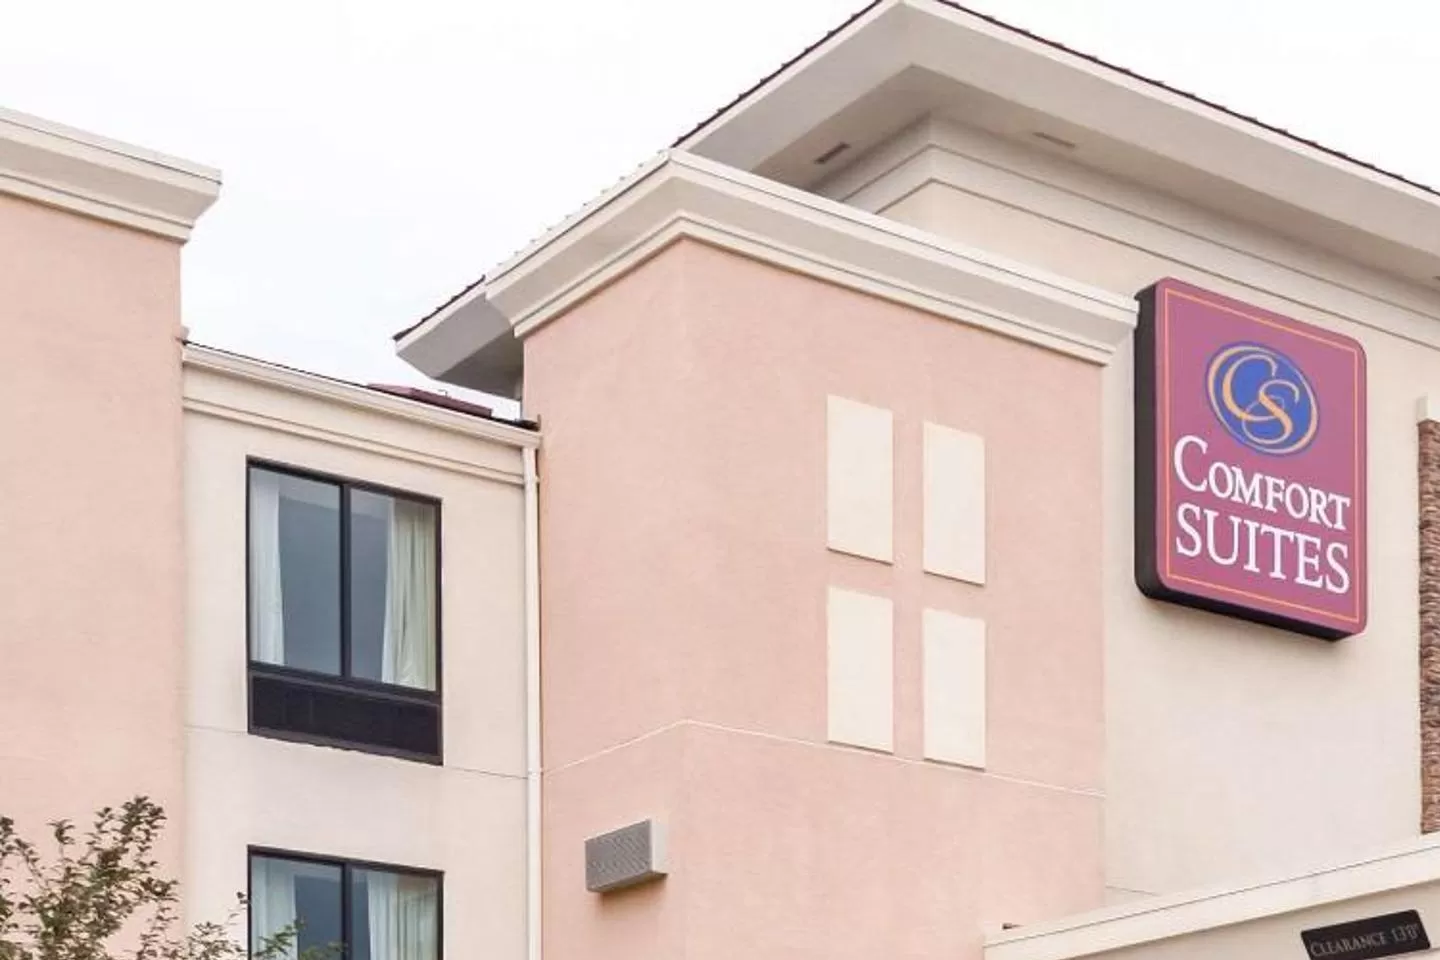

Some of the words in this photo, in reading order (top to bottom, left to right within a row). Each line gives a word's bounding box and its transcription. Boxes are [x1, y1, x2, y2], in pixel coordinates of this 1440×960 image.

[1174, 435, 1350, 531] COMFORT
[1176, 503, 1349, 594] SUITES
[1310, 931, 1388, 957] CLEARANCE
